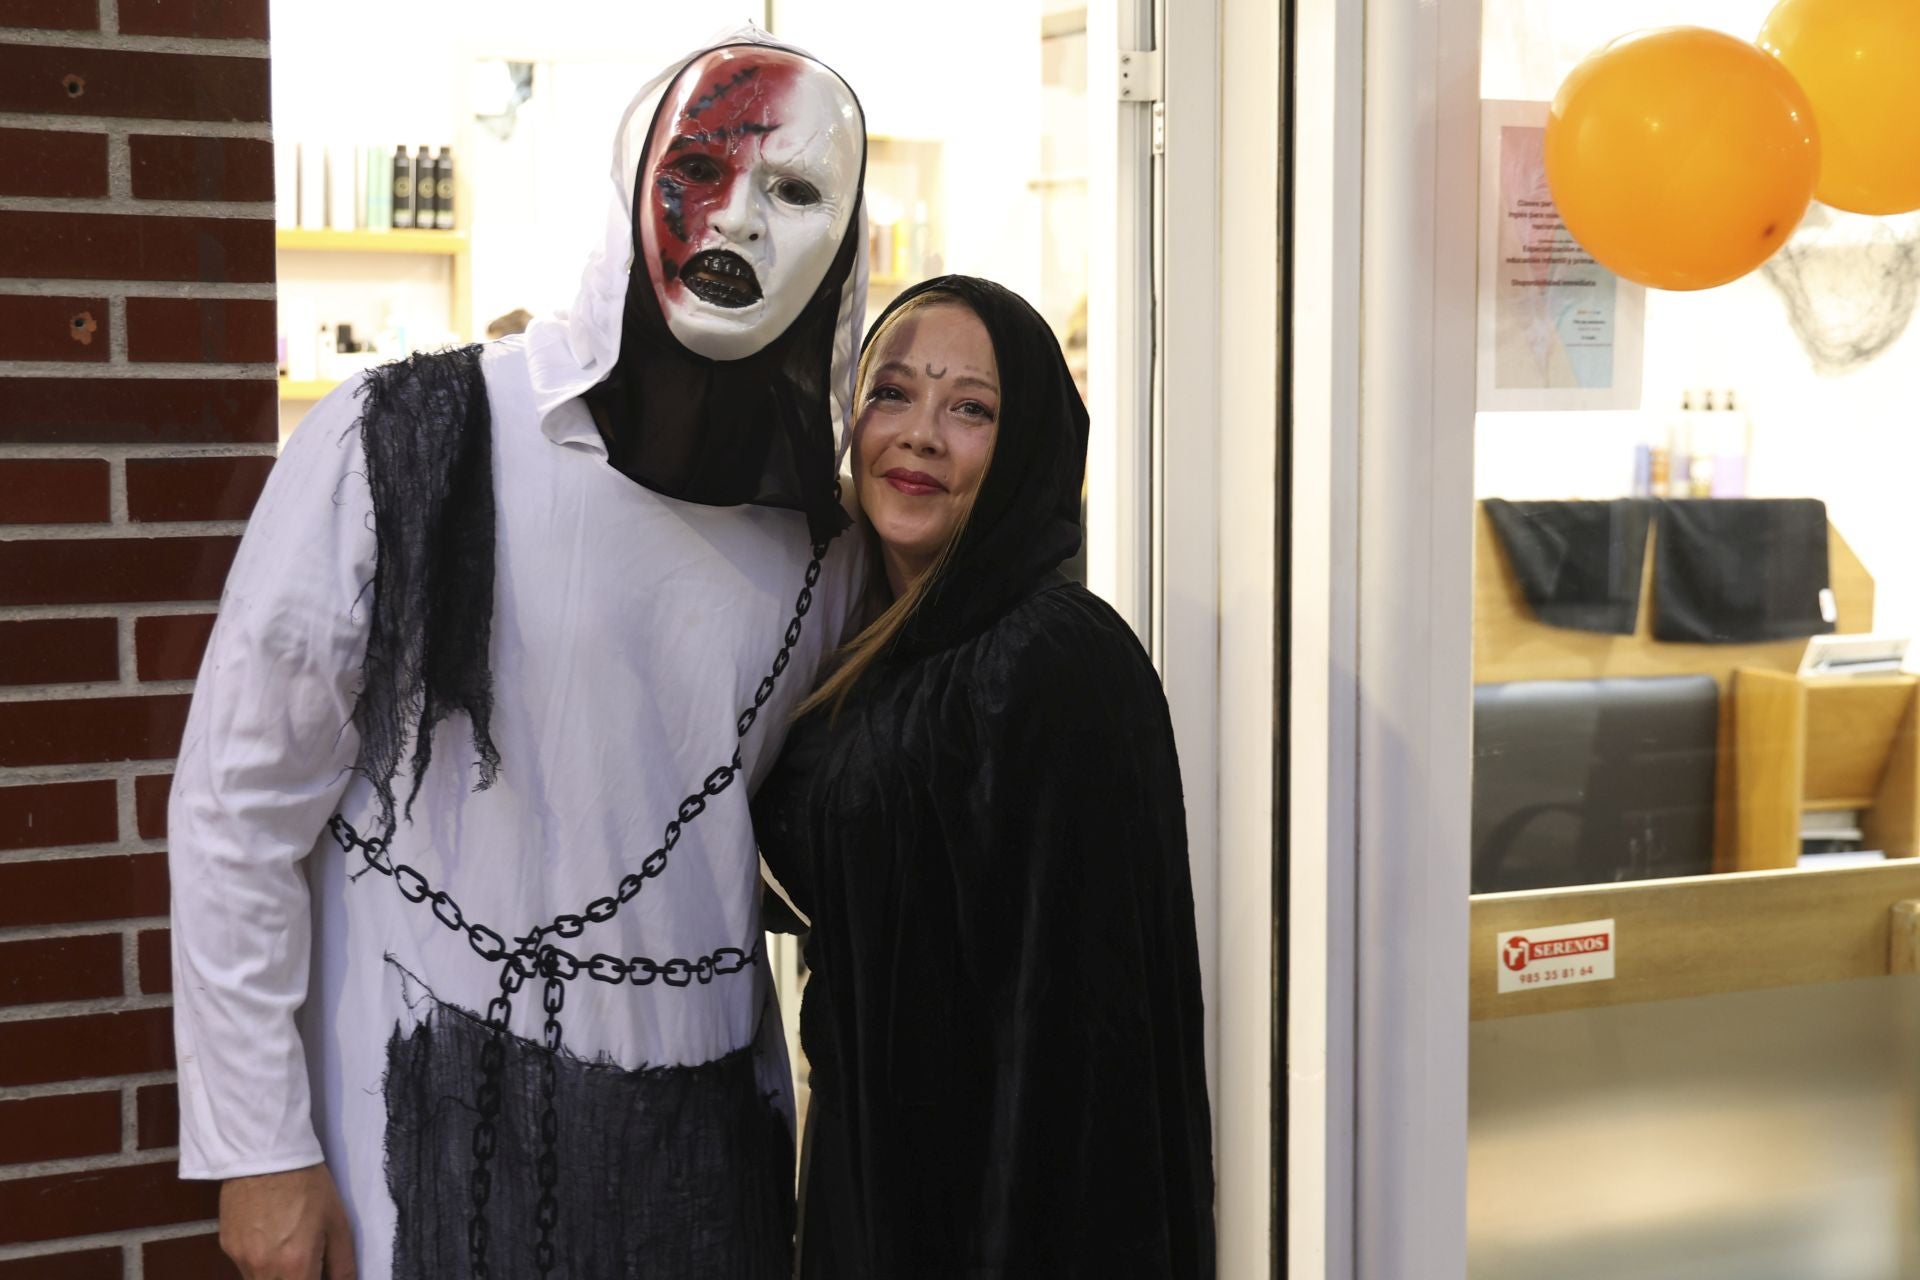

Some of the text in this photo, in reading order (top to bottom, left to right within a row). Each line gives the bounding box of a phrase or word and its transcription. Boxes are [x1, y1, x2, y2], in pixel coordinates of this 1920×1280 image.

[1534, 937, 1605, 957] SERENOS
[1519, 972, 1540, 984] 985
[1544, 970, 1558, 981] 35
[1562, 967, 1575, 979] 81
